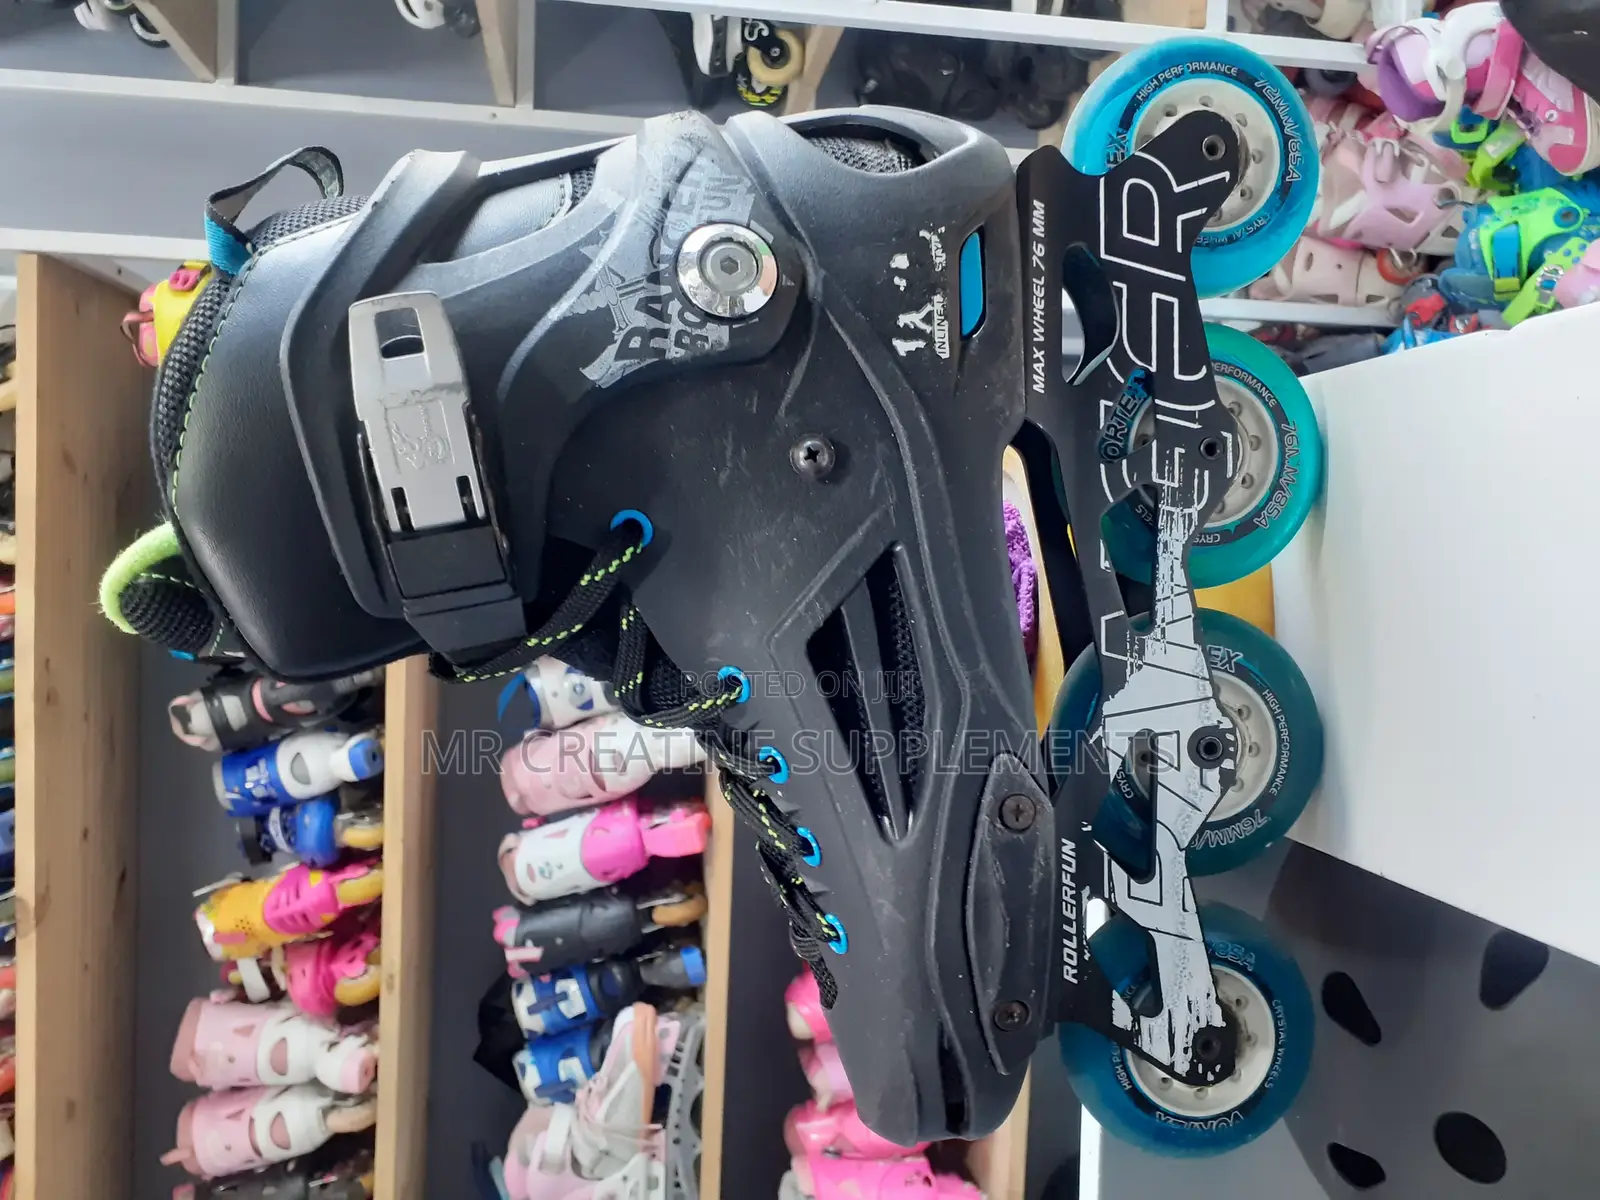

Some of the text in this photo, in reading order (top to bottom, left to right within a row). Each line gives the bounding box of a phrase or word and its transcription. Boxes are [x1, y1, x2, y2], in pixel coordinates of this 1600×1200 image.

[1136, 61, 1238, 102] HIGH PERFORMANCE
[935, 307, 948, 355] INLINE
[1032, 199, 1046, 394] MAX WHEEL 76 MM
[1211, 361, 1278, 408] ERFORMANCE
[1252, 420, 1300, 530] 76MM/85A
[1262, 689, 1292, 796] HIGH PERFORMANCE
[1060, 838, 1078, 984] ROLLERFUN
[1115, 1064, 1133, 1091] HIGH
[1264, 998, 1287, 1090] CRYSTAL WHEELS
